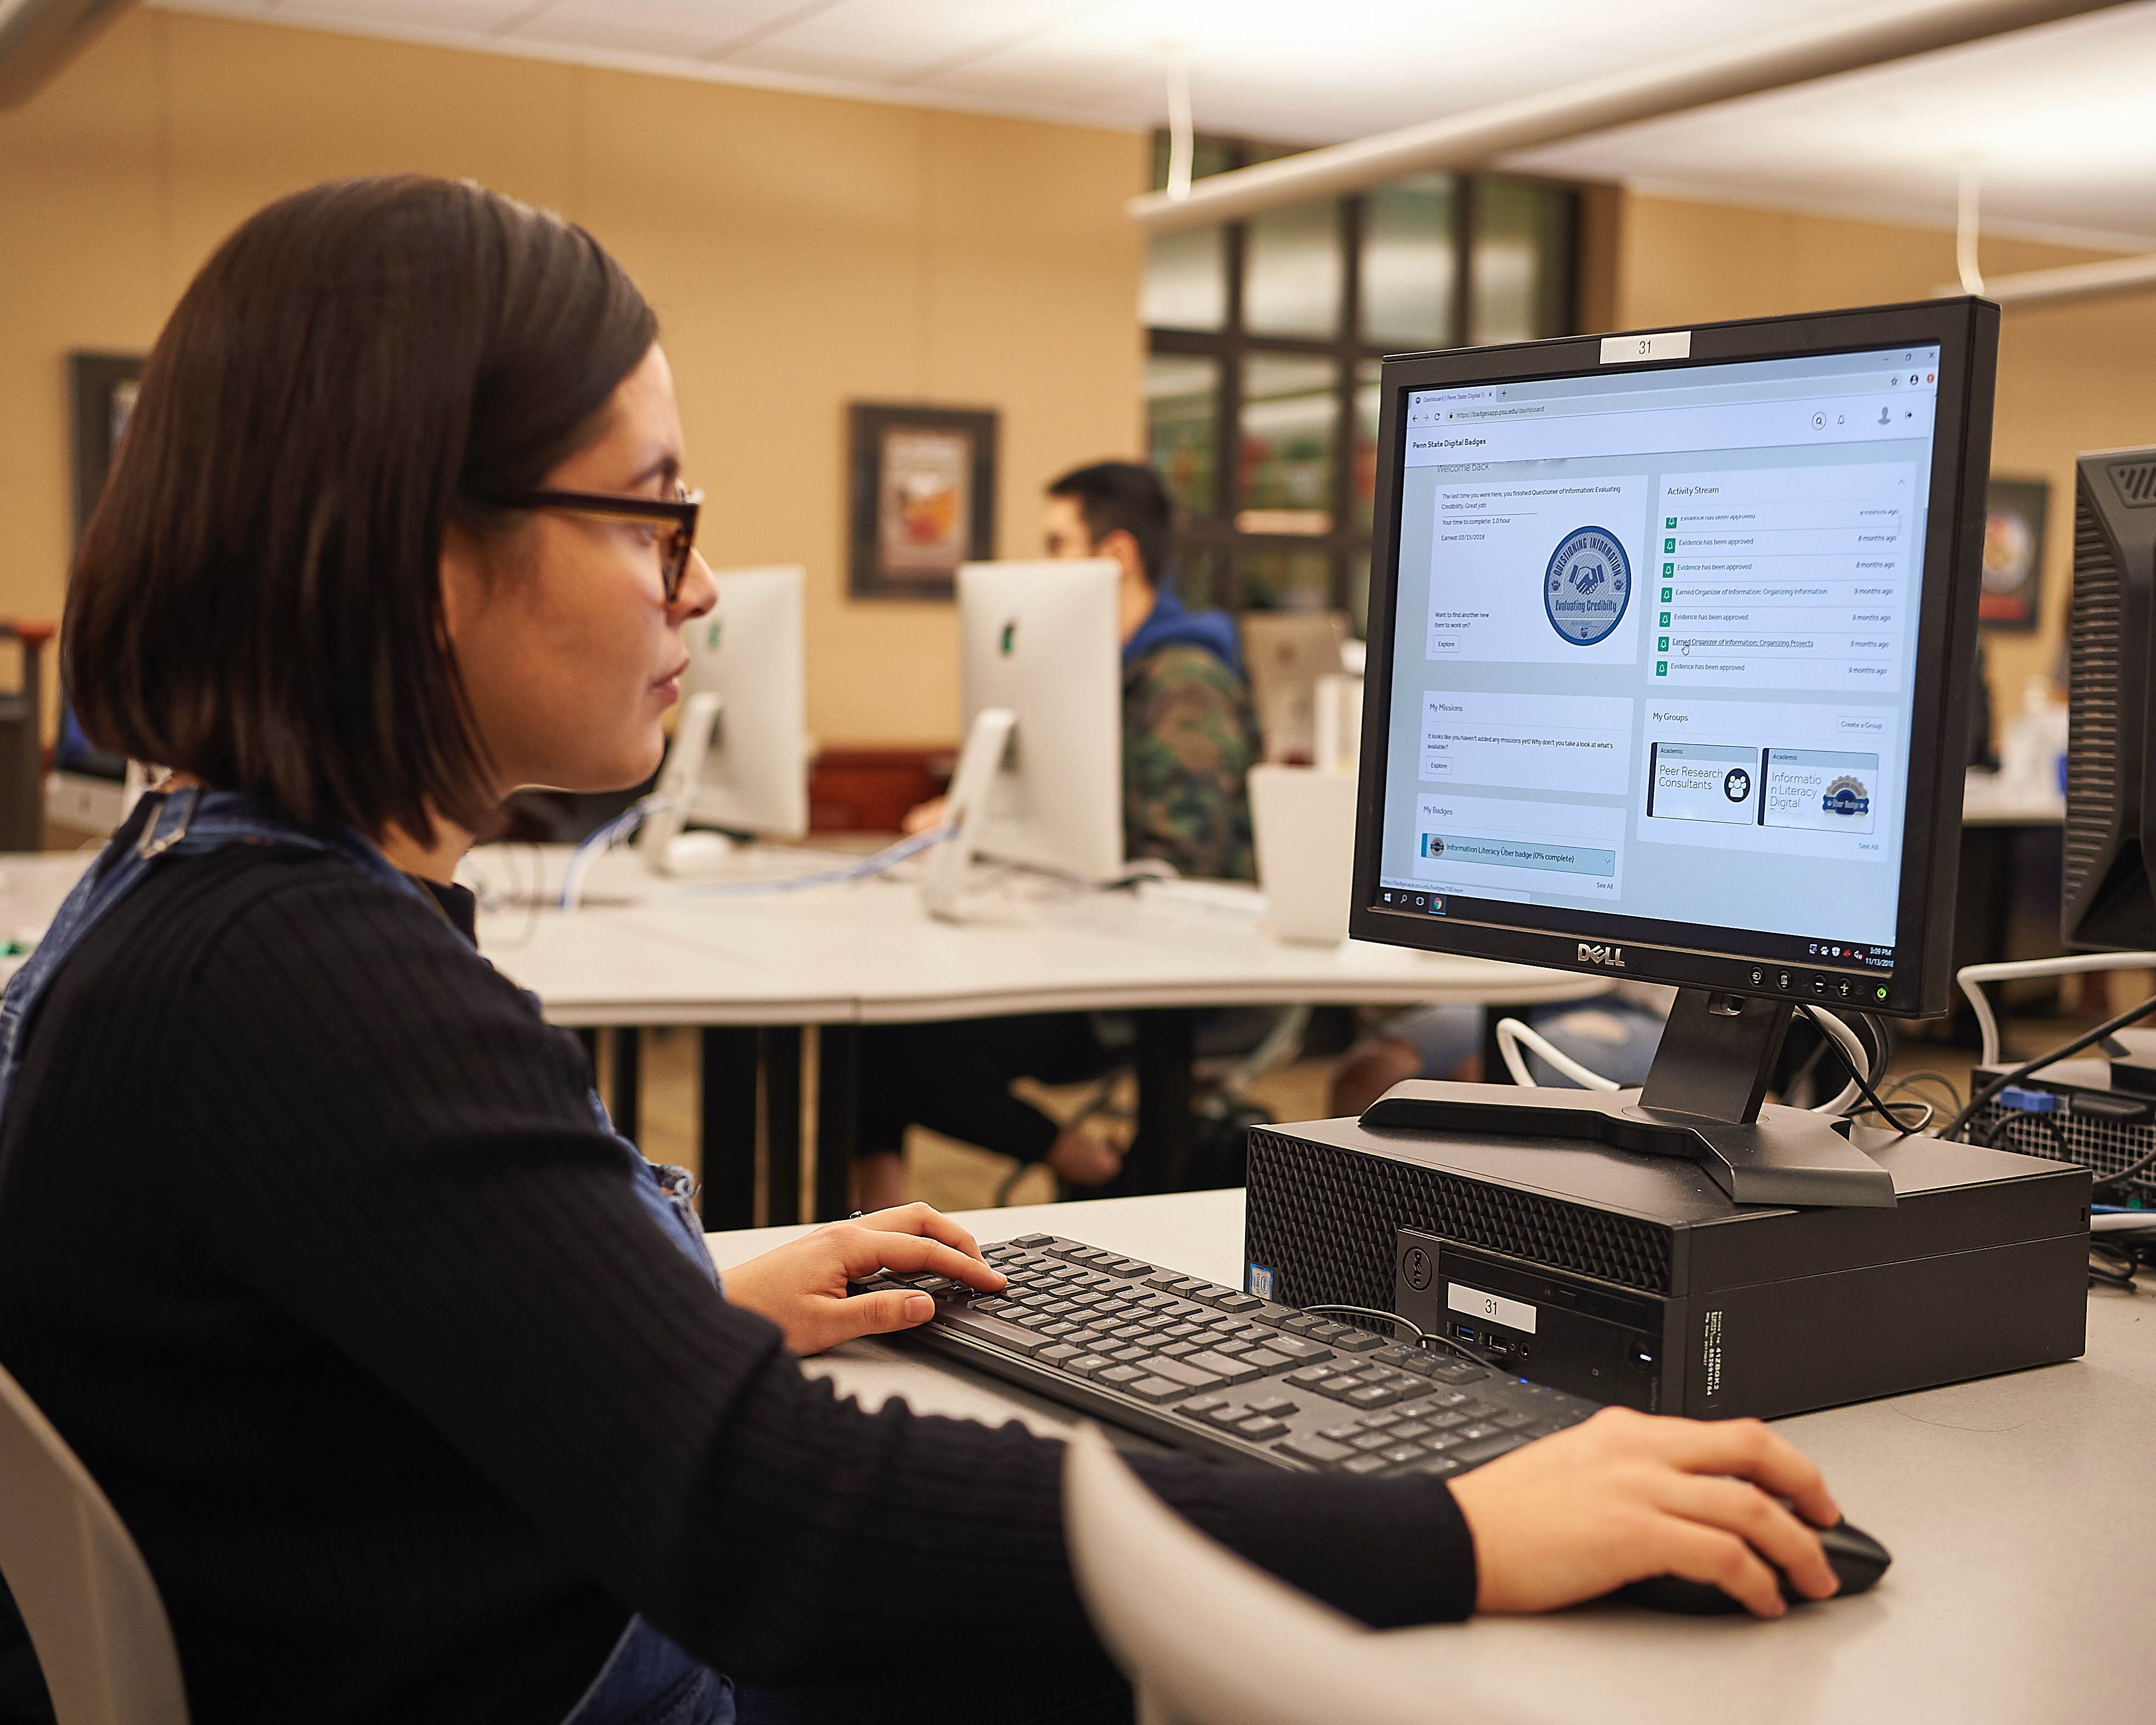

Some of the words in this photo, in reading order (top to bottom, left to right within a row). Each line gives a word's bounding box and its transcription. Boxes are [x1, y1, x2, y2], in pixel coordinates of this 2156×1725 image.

[1639, 340, 1651, 354] 31
[1444, 439, 1463, 448] Digital
[1465, 438, 1486, 448] Badges
[1437, 464, 1470, 473] Welcome
[1472, 463, 1489, 472] back
[1668, 487, 1693, 496] Activity
[1553, 538, 1587, 576] QUESTIONING
[1590, 537, 1622, 577] INFORMATION
[1556, 600, 1585, 612] Evaluating
[1429, 704, 1437, 712] My
[1439, 704, 1463, 712] Missions
[1653, 713, 1663, 722] My
[1664, 713, 1688, 723] Groups
[1865, 721, 1882, 730] Group
[1660, 765, 1680, 776] Peer
[1682, 766, 1722, 778] Research
[1659, 777, 1712, 790] Consultants
[1772, 772, 1821, 785] Informatio
[1780, 785, 1817, 799] Literacy
[1770, 796, 1800, 809] Digital
[1423, 806, 1432, 815] My
[1433, 807, 1453, 816] Badges
[1446, 844, 1477, 853] Information
[1478, 847, 1500, 856] Literacy
[1515, 851, 1533, 859] badge
[1545, 854, 1574, 863] complete)
[1578, 943, 1625, 967] DELL
[1413, 1252, 1422, 1285] DELL
[1485, 1299, 1497, 1315] 31
